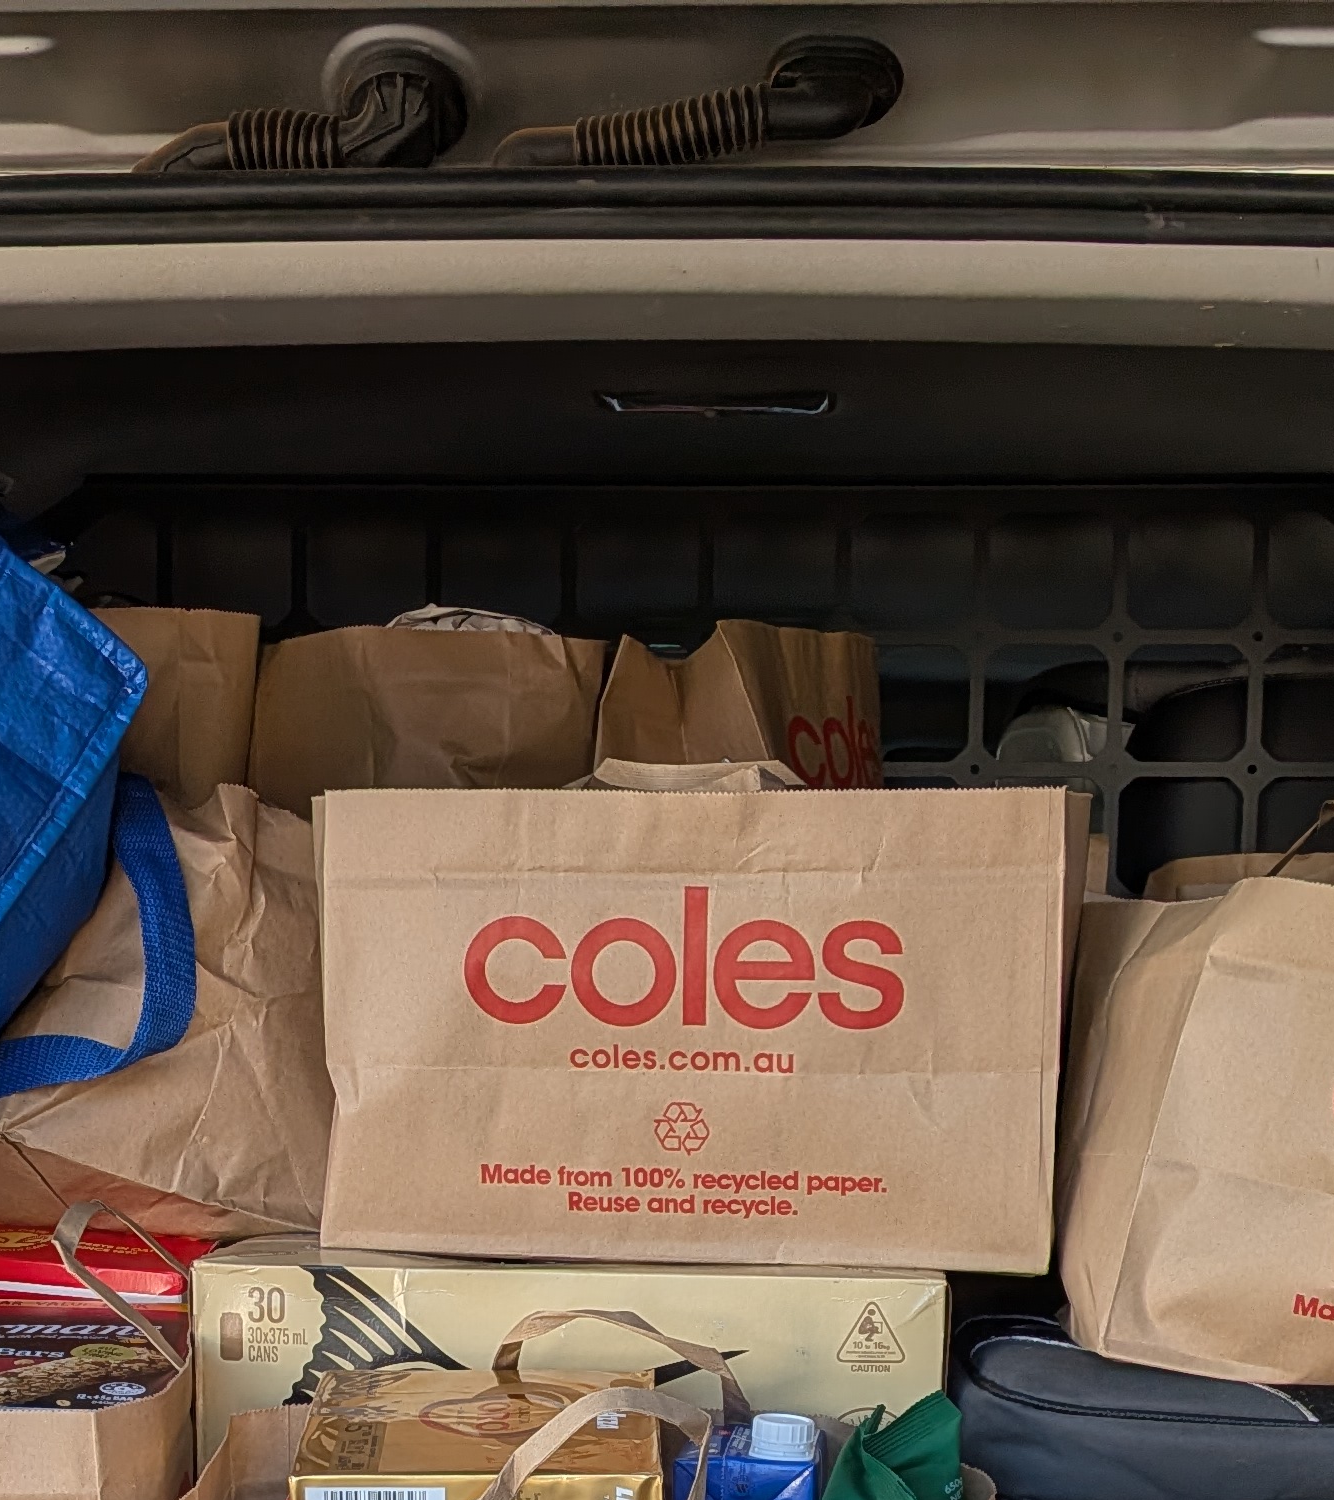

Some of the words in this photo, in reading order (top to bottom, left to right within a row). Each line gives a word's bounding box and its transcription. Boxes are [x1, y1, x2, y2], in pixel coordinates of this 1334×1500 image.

[464, 886, 905, 1029] coles
[569, 1044, 795, 1074] coles.com.au
[480, 1164, 551, 1187] Made
[557, 1166, 613, 1189] from
[621, 1166, 686, 1190] 100%
[693, 1169, 800, 1198] recycled
[806, 1174, 888, 1200] paper.
[568, 1192, 641, 1215] Reuse
[647, 1194, 697, 1215] and
[702, 1195, 799, 1220] recycle.
[248, 1287, 286, 1323] 30
[248, 1327, 289, 1345] 30x375
[292, 1328, 308, 1345] mL
[853, 1341, 862, 1349] 10
[248, 1345, 279, 1362] CANS
[851, 1364, 891, 1373] CAUTION
